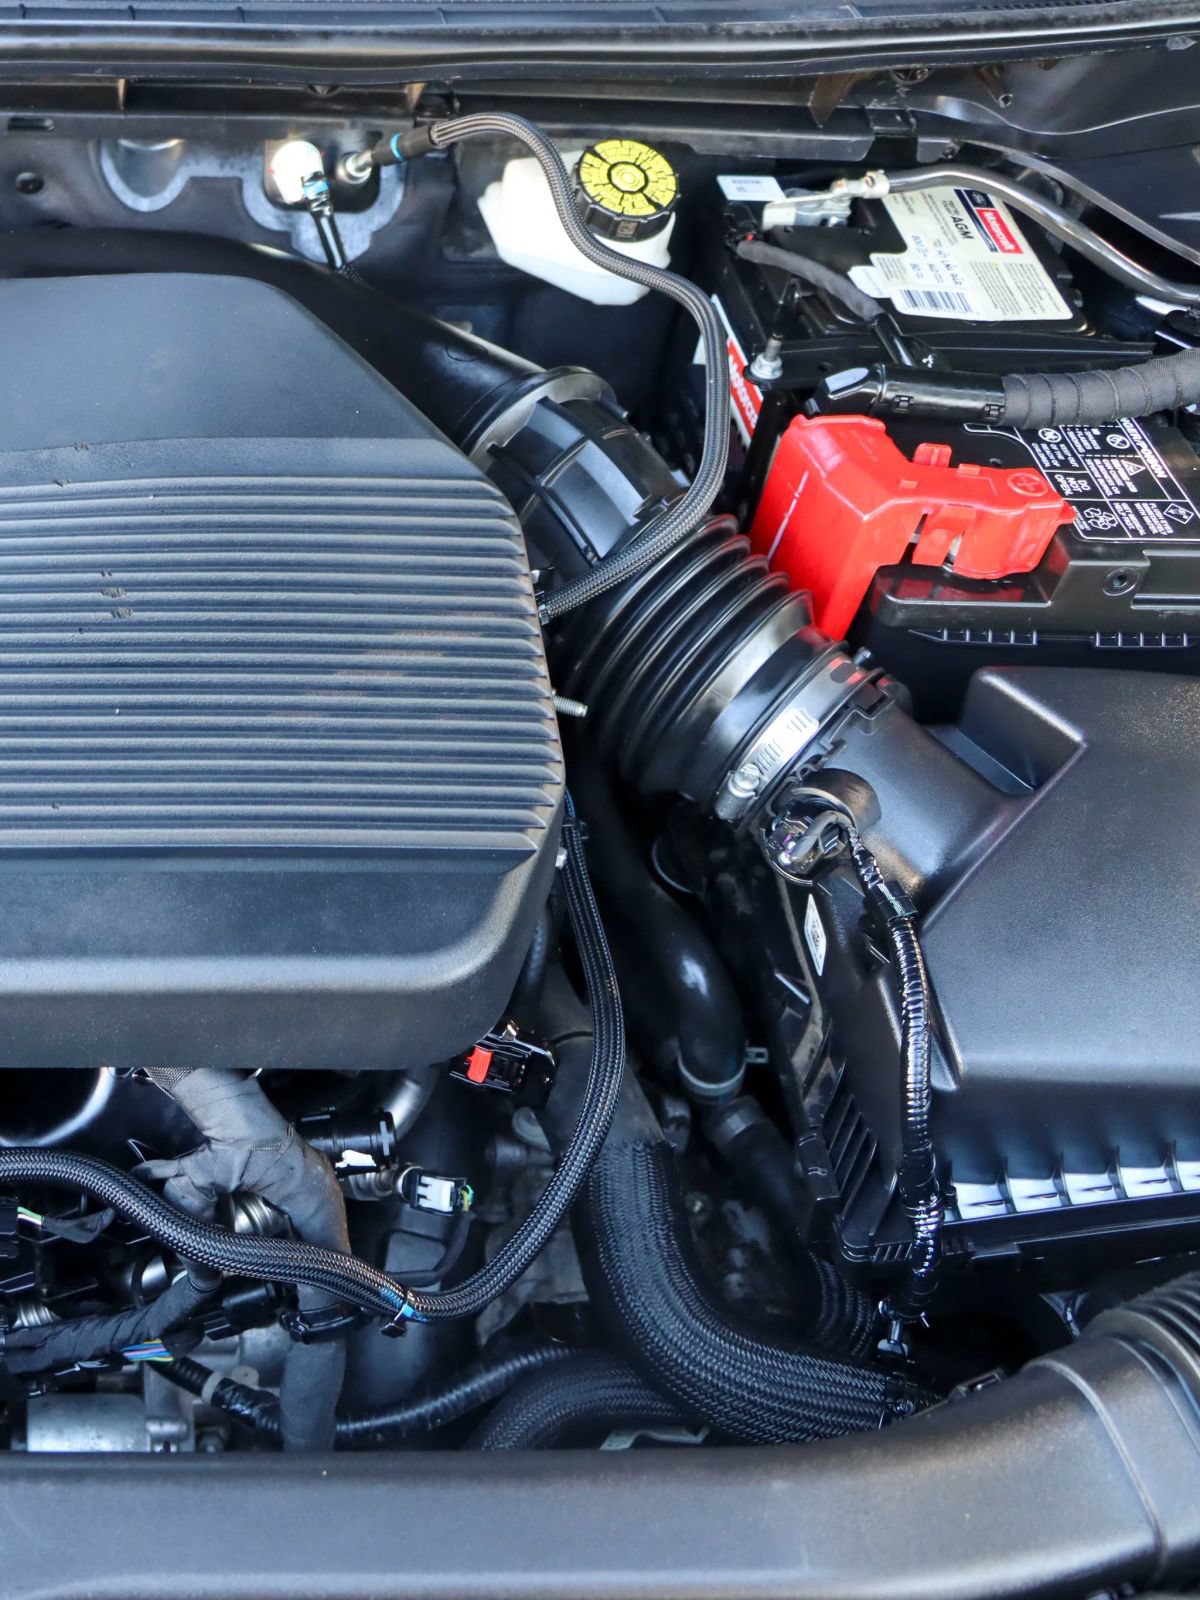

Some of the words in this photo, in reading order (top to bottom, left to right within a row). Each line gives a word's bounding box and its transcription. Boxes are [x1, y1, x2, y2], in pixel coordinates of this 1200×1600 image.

[952, 216, 975, 239] AGM
[983, 211, 1015, 250] Motorcraft
[1065, 477, 1083, 493] NOT
[1077, 480, 1091, 491] DO
